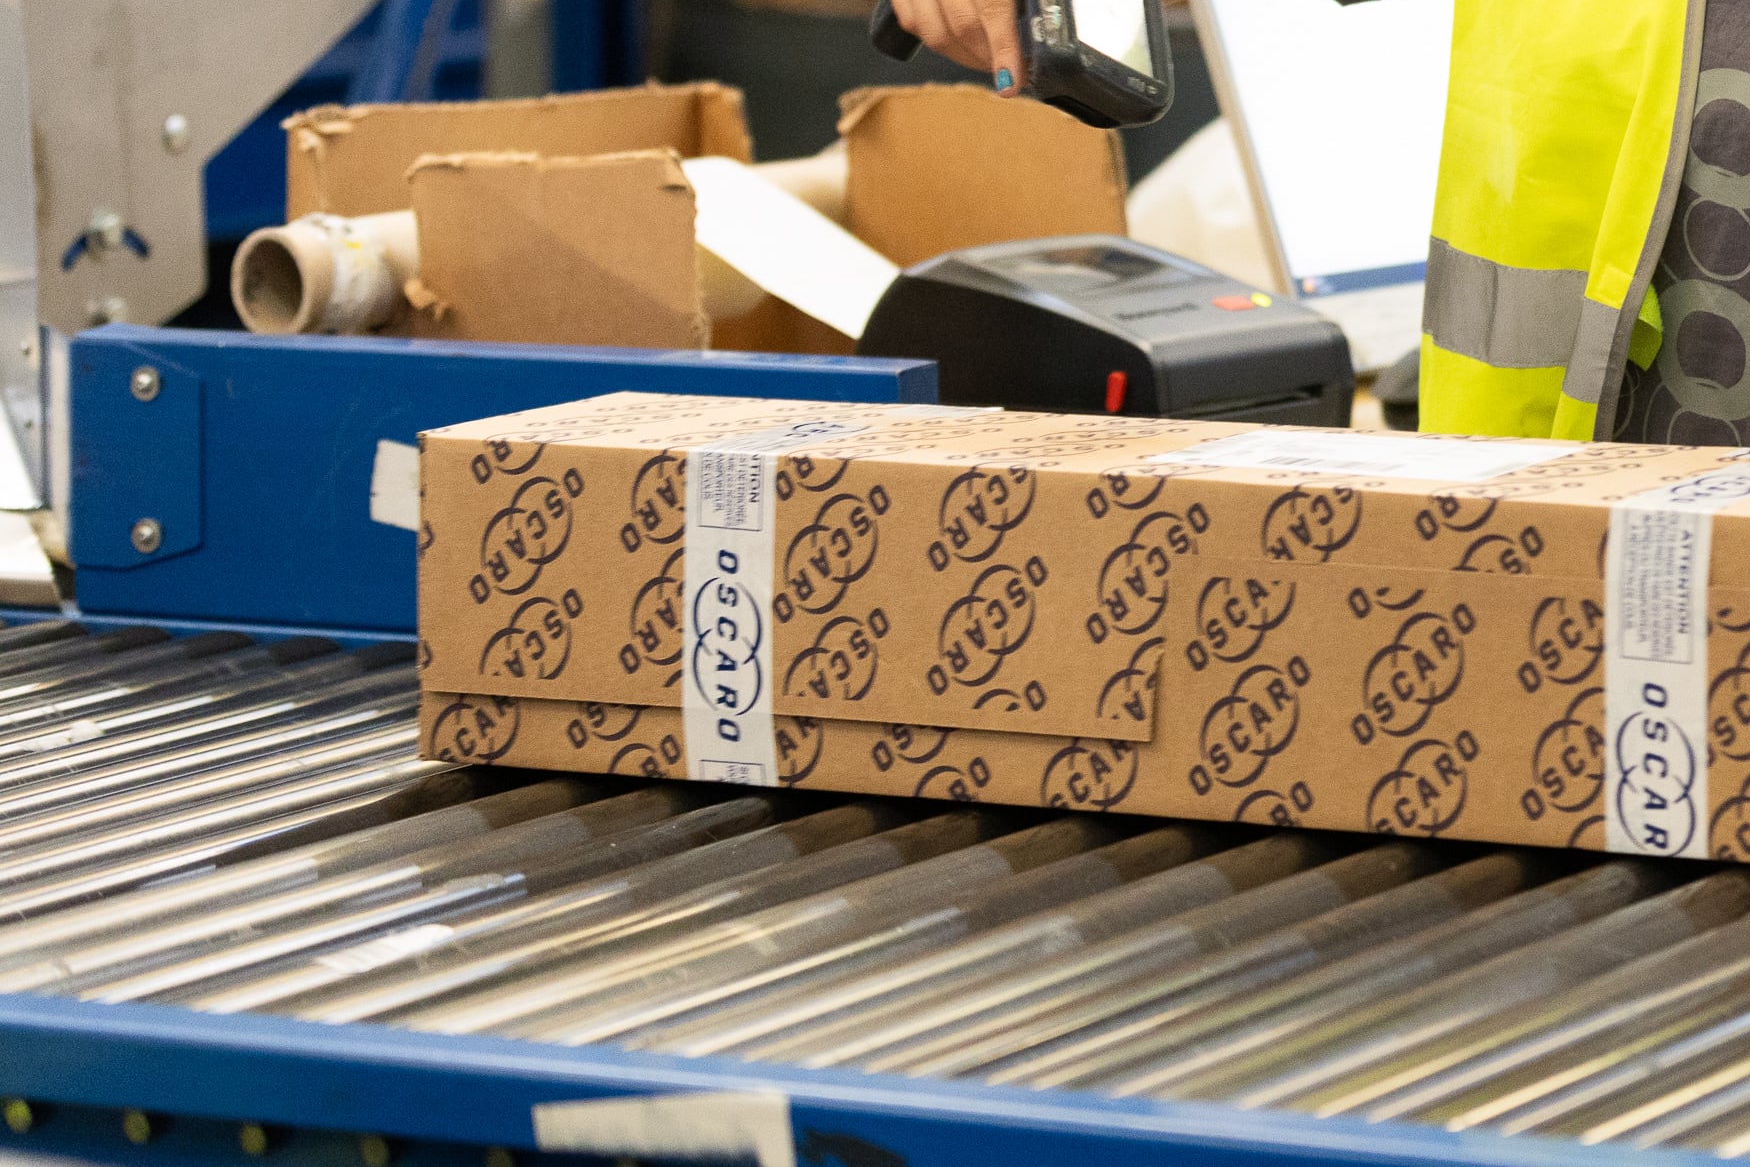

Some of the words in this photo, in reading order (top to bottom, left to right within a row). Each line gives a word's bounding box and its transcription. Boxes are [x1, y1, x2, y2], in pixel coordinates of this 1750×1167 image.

[469, 467, 584, 604] OSCARO
[773, 485, 891, 624] OSCARO
[1085, 502, 1210, 644] OSCARO
[493, 588, 584, 678] OSCA
[715, 549, 741, 743] OSCARO
[797, 607, 890, 699] OSCA
[926, 555, 1048, 695] OSCARO
[1186, 578, 1281, 672] OSCA
[1351, 603, 1477, 746] OSCARO
[1517, 599, 1605, 694] OSCA
[1189, 655, 1311, 796] OSCARO
[1521, 725, 1606, 821] OSCA
[1643, 681, 1669, 849] OSCAR
